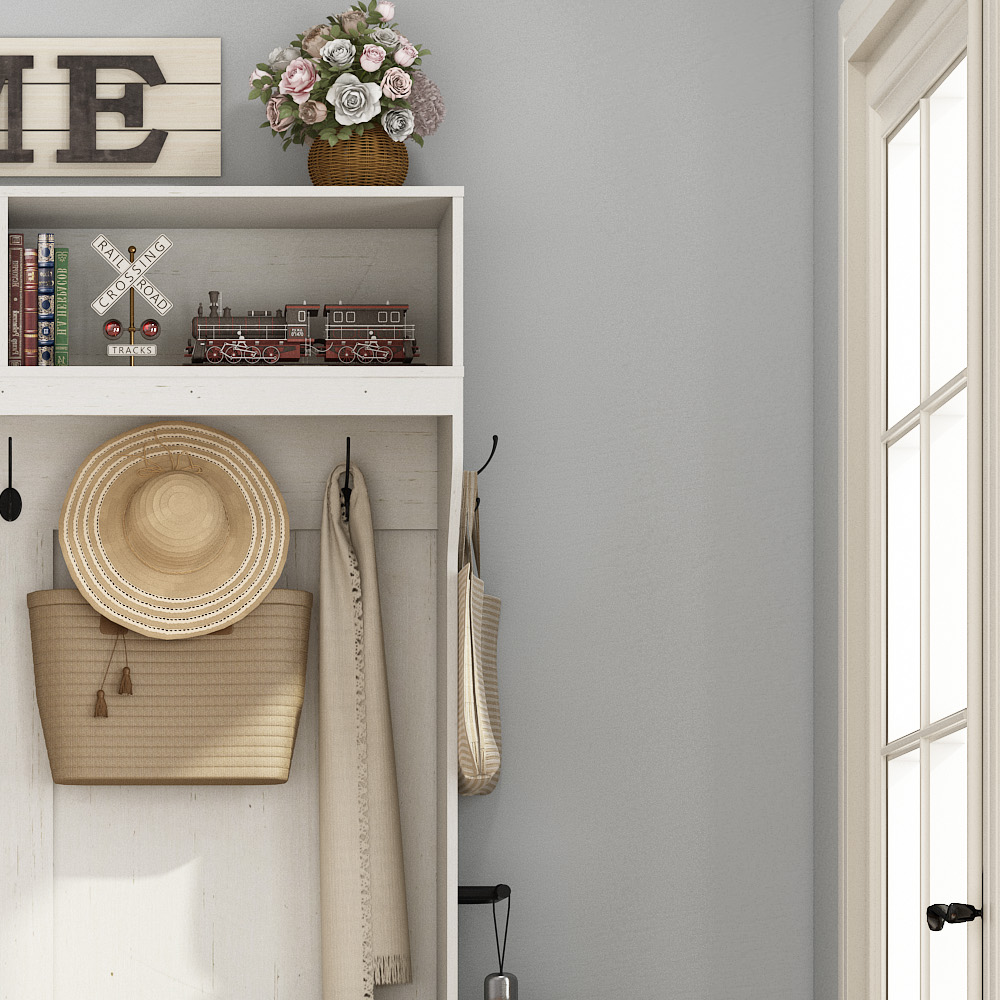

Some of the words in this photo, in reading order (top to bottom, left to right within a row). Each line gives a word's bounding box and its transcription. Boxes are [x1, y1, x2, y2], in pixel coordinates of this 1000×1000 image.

[97, 240, 124, 270] RAIL
[136, 279, 168, 311] ROAD
[98, 241, 166, 308] CROSSING
[112, 346, 152, 354] TRACKS
